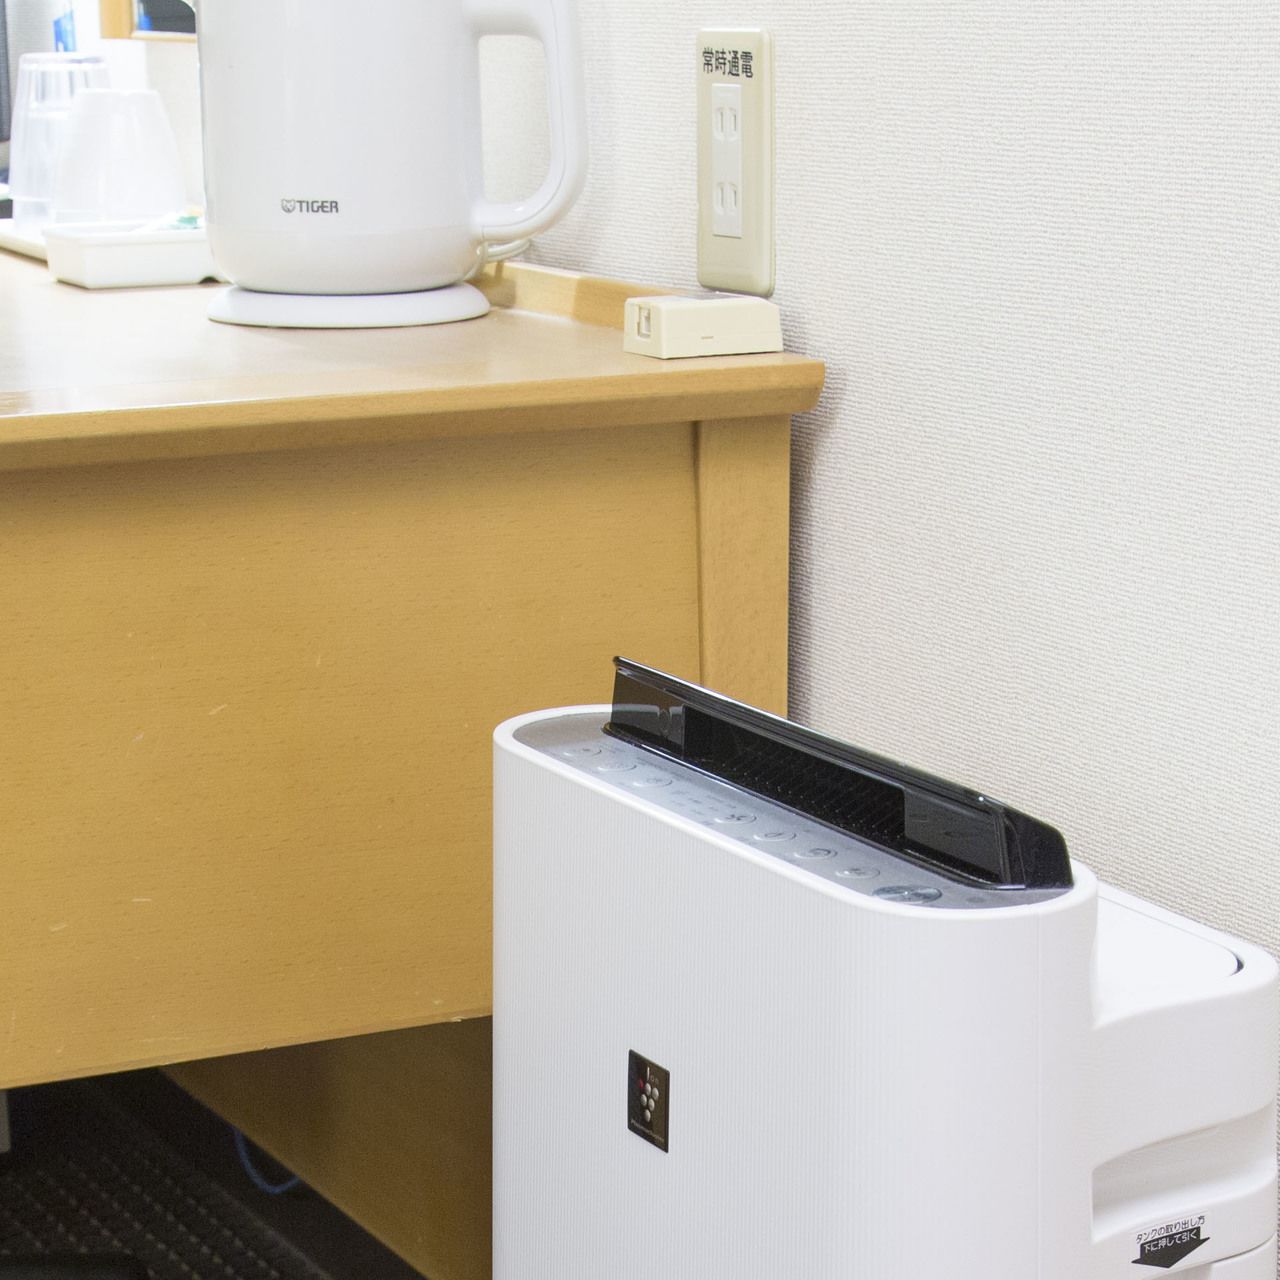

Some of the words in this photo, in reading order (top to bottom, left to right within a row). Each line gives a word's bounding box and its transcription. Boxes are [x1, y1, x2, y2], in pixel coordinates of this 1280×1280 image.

[702, 46, 754, 78] 常時通電
[296, 199, 339, 213] TIGER
[1136, 1215, 1205, 1244] タンクの取り出し方
[1143, 1229, 1197, 1253] 下に押して引く
